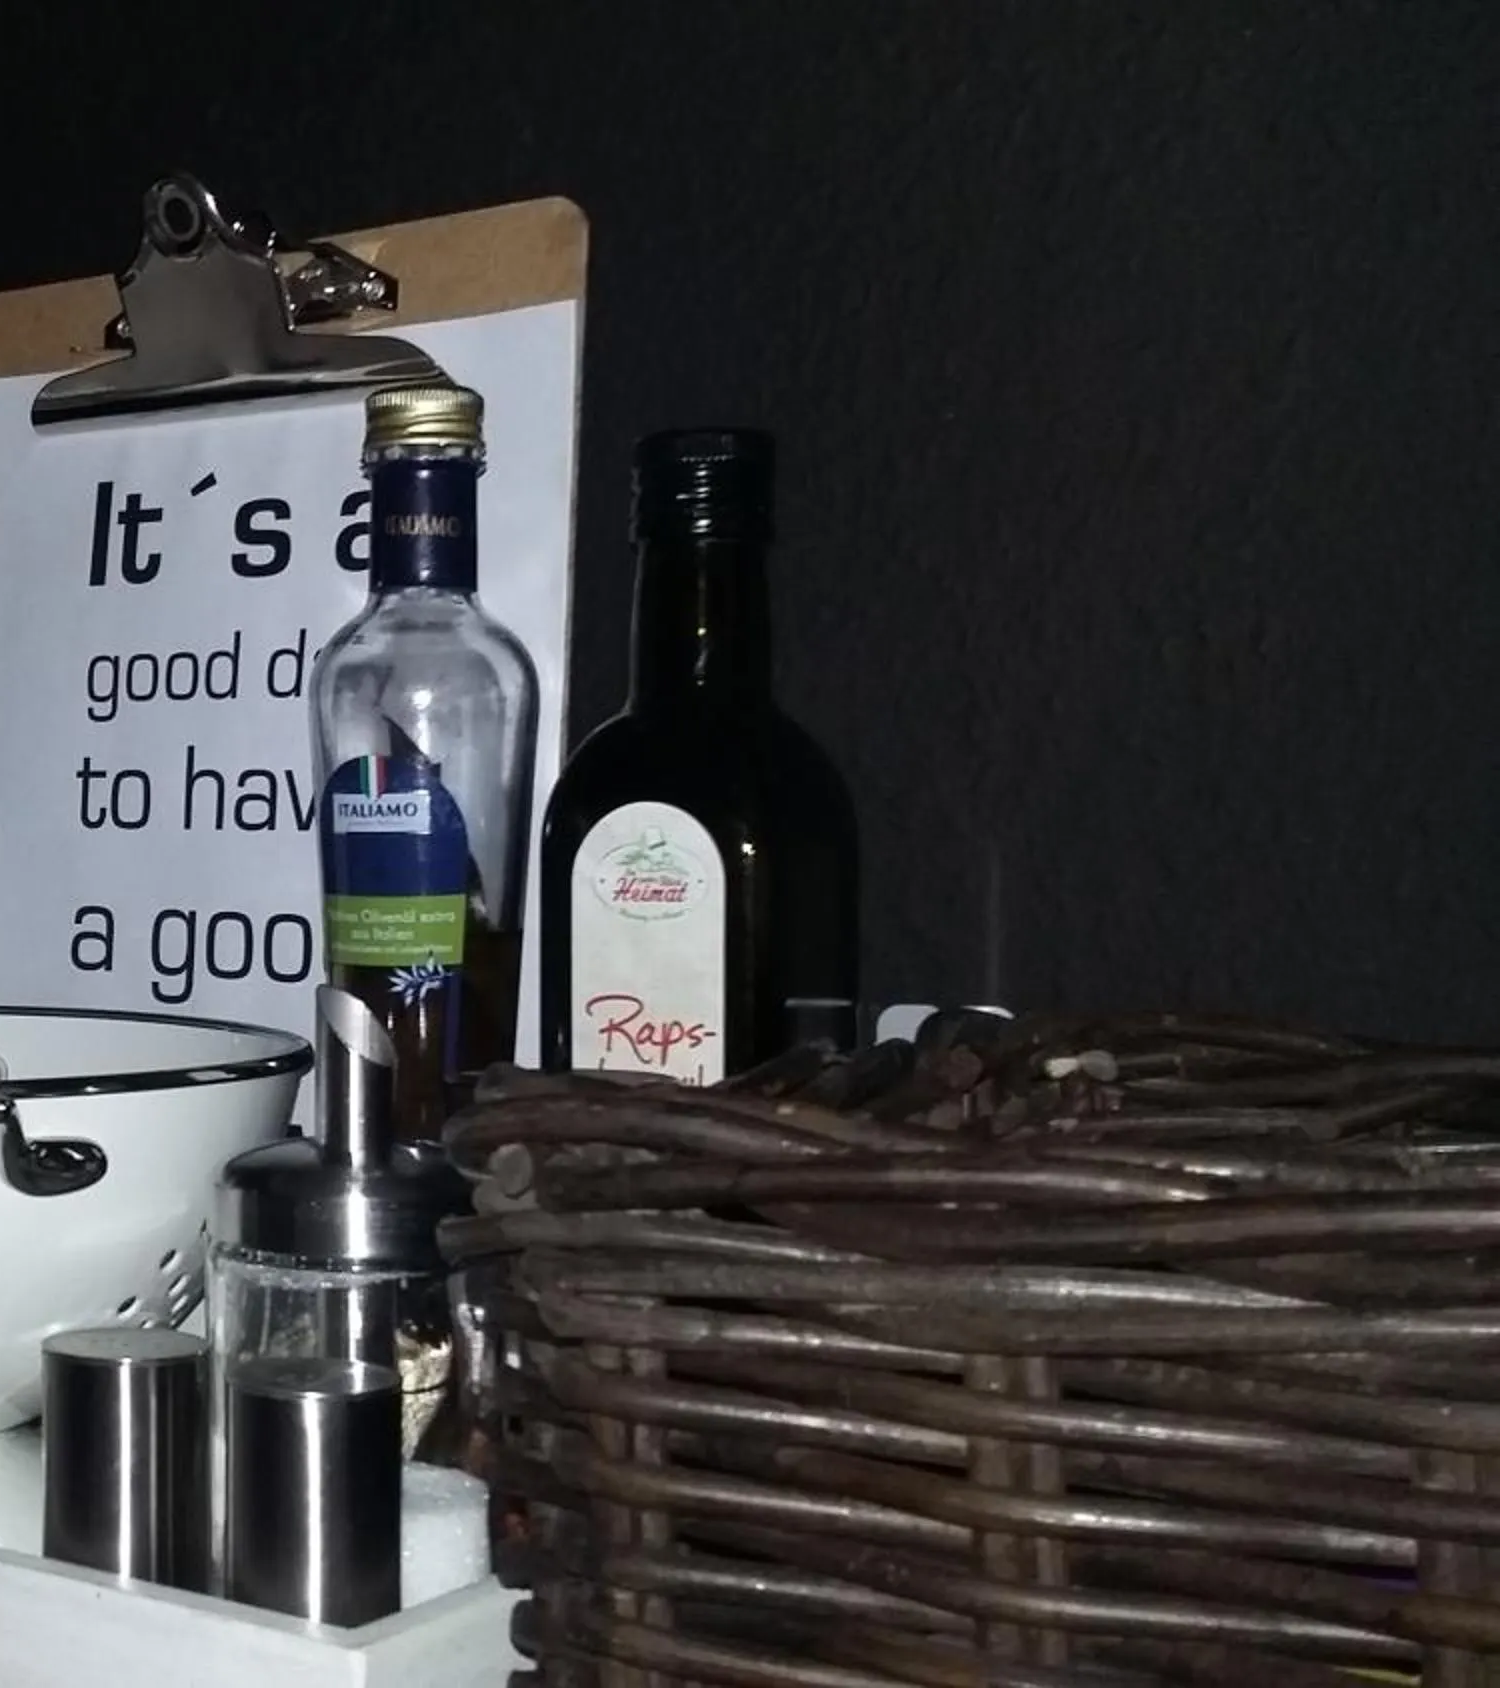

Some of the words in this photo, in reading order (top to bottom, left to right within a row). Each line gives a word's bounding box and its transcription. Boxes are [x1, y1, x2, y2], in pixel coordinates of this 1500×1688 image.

[86, 630, 242, 722] good
[76, 756, 152, 831] to
[182, 745, 317, 832] hav
[338, 801, 419, 820] ITALIAMO
[612, 876, 689, 905] Heimat
[70, 904, 114, 972] a
[150, 908, 313, 1004] goo
[585, 993, 717, 1066] Raps-
